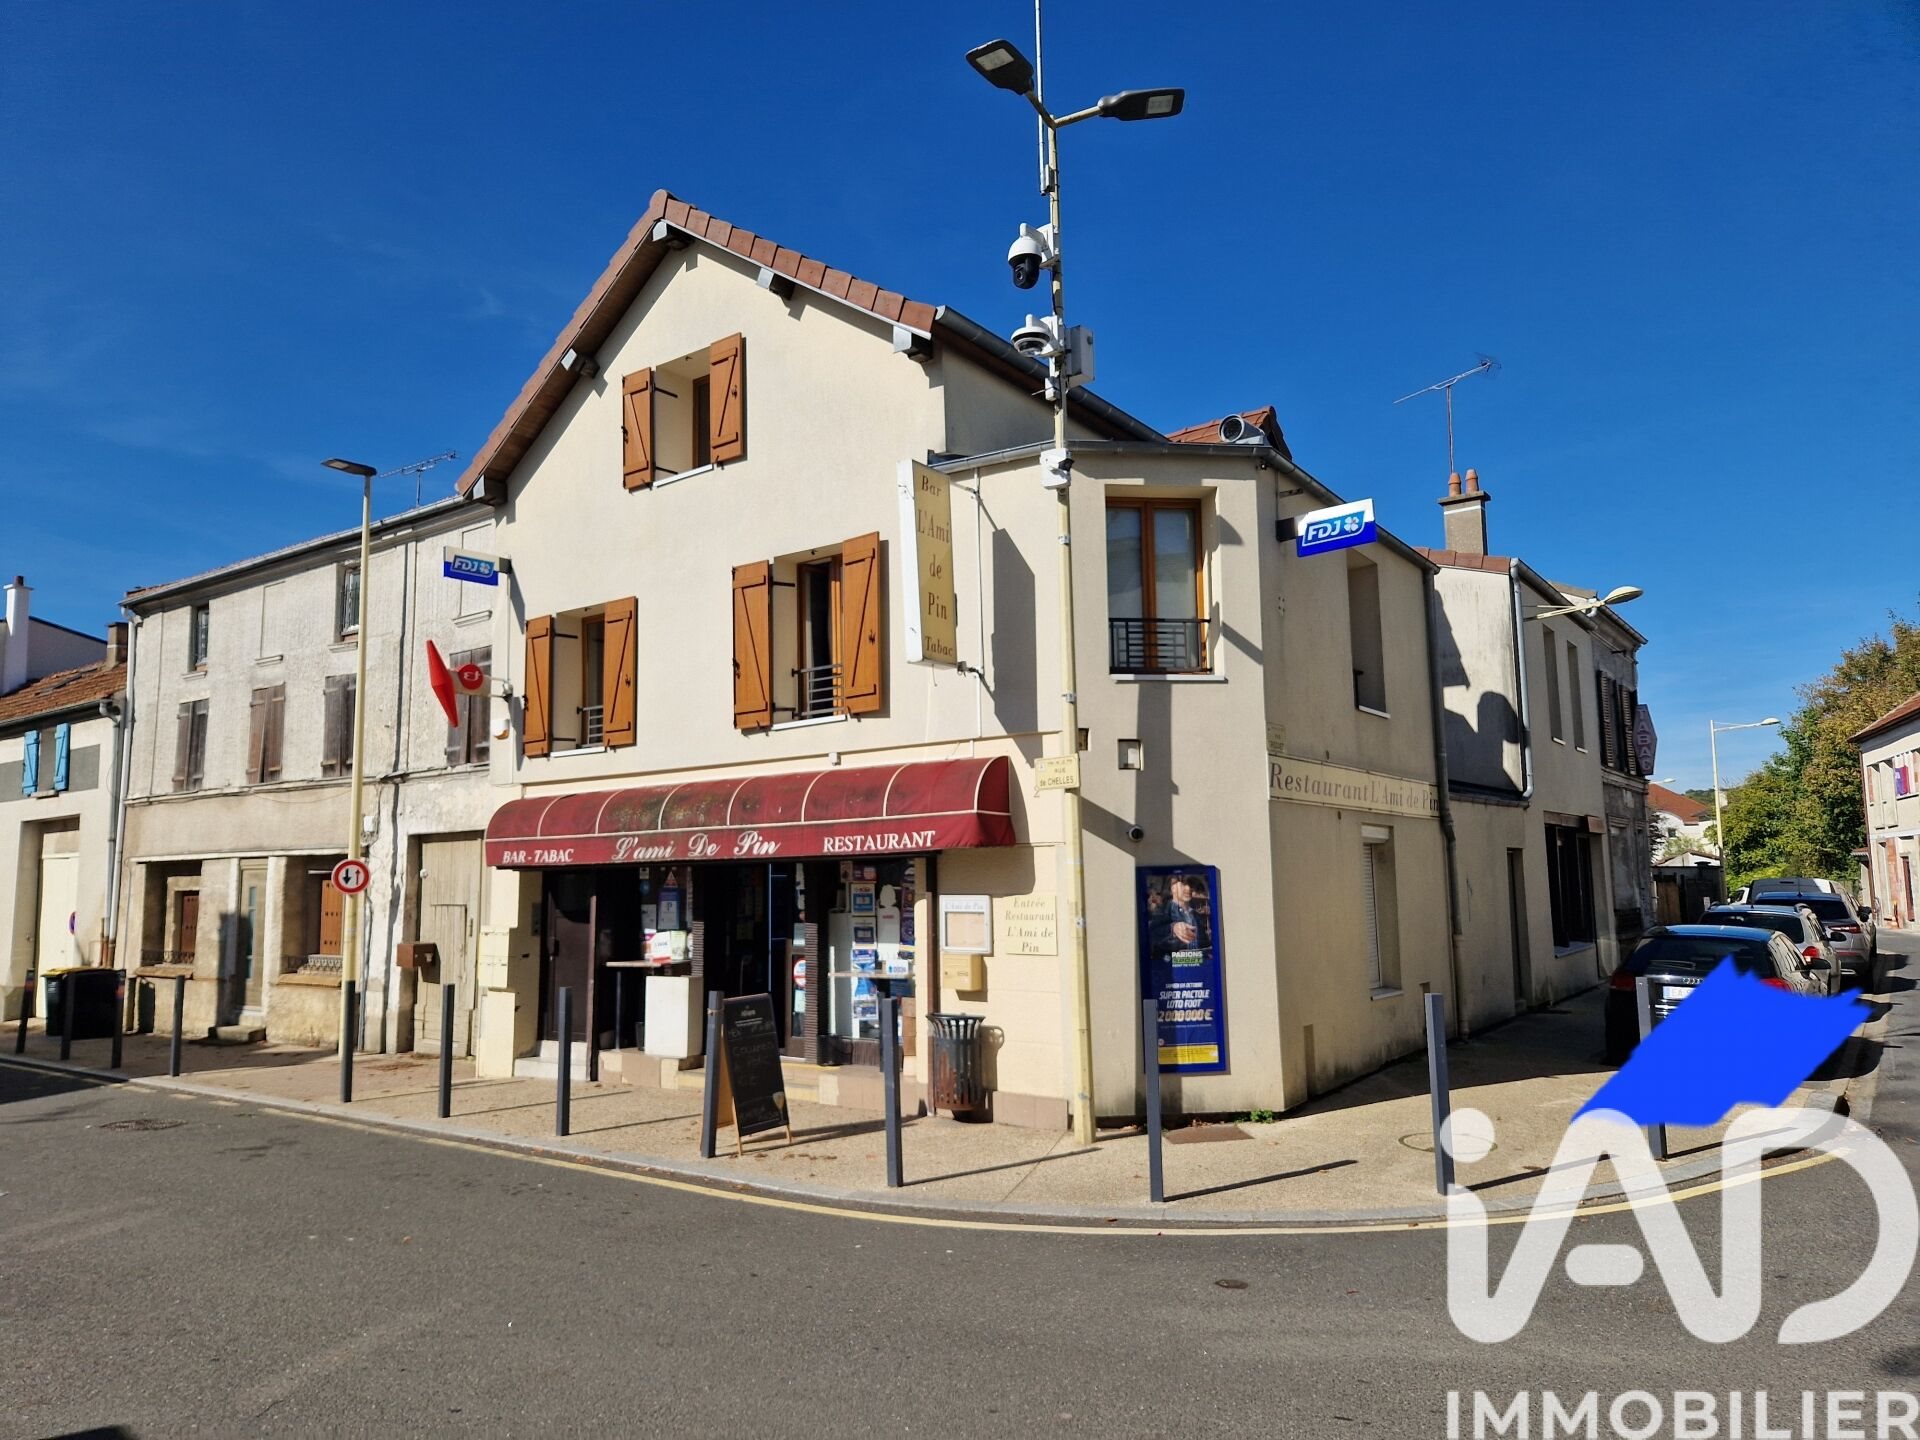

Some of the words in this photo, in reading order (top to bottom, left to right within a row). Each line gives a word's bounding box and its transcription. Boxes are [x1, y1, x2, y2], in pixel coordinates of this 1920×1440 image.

[921, 475, 942, 497] Bar
[917, 508, 950, 544] L'Ami
[1307, 520, 1342, 541] FDJ
[454, 557, 479, 573] FDJ
[929, 554, 942, 579] de
[928, 591, 947, 620] Pin
[924, 635, 953, 657] Tabac
[1637, 709, 1652, 774] TABAC
[1047, 775, 1074, 786] CHELLES
[1270, 762, 1368, 802] Restaurant
[1371, 780, 1403, 807] L'Ami
[1407, 787, 1419, 808] de
[1422, 790, 1440, 811] Pin
[611, 836, 675, 861] L'ami
[687, 832, 721, 857] De
[733, 830, 781, 856] Pin
[823, 830, 936, 852] RESTAURANT
[502, 850, 526, 864] BAR
[534, 848, 575, 863] TABAC
[1005, 910, 1055, 921] Restaurant
[1007, 925, 1037, 938] L'Ami
[1041, 927, 1055, 938] de
[1022, 941, 1040, 953] Pin
[1171, 951, 1203, 959] PARIONS
[1160, 991, 1181, 1000] SUPER
[1182, 989, 1210, 998] PACTOLE
[1167, 1000, 1183, 1008] LOTO
[1184, 999, 1204, 1008] FOOT
